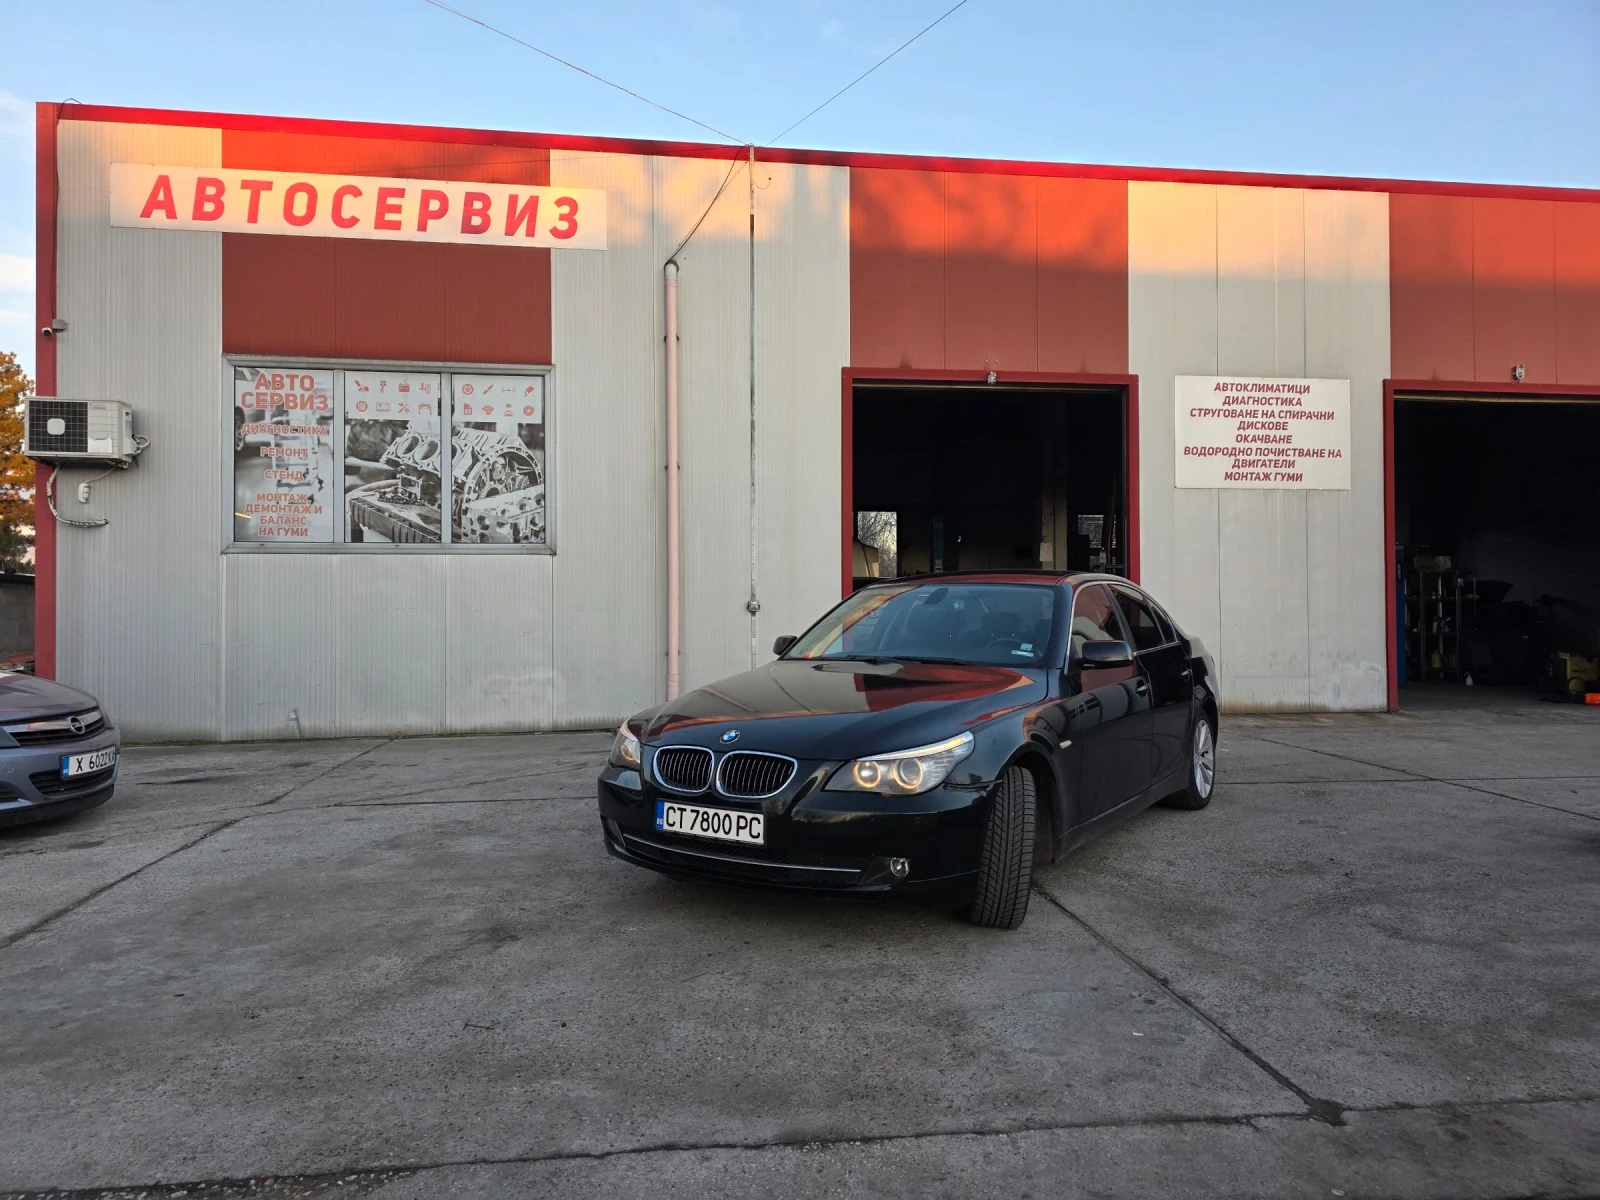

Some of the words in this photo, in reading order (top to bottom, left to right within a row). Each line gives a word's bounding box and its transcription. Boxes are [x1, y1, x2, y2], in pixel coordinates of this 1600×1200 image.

[139, 174, 580, 240] АВТОСЕРВИЗ
[254, 373, 315, 392] АВТО
[1214, 382, 1311, 395] АВТОКЛИМАТИЦИ
[240, 391, 329, 411] СЕРВИЗ
[1222, 395, 1303, 407] ДИАГНОСТИКА
[1190, 408, 1259, 419] СТРУГОВАНЕ
[1261, 409, 1276, 419] НА
[1278, 410, 1335, 421] СПИРАЧНИ
[241, 424, 327, 436] ДИАГНОСТИКА
[1237, 420, 1289, 432] ДИСКОВЕ
[1235, 433, 1293, 444] ОКАЧВАНЕ
[260, 447, 308, 458] РЕМОНТ
[1183, 446, 1253, 458] ВОДОРОДНО
[1254, 448, 1326, 458] ПОЧИСТВАНЕ
[1327, 449, 1343, 458] НА
[1231, 458, 1296, 470] ДВИГАТЕЛИ
[264, 470, 304, 481] СТЕНД
[1224, 471, 1272, 482] МОНТАЖ
[1273, 472, 1304, 482] ГУМИ
[244, 504, 312, 515] ДЕМОНТАЖ
[314, 505, 323, 515] И
[260, 515, 307, 526] БАЛАНС
[258, 527, 275, 536] НА
[276, 527, 308, 537] ГУМИ
